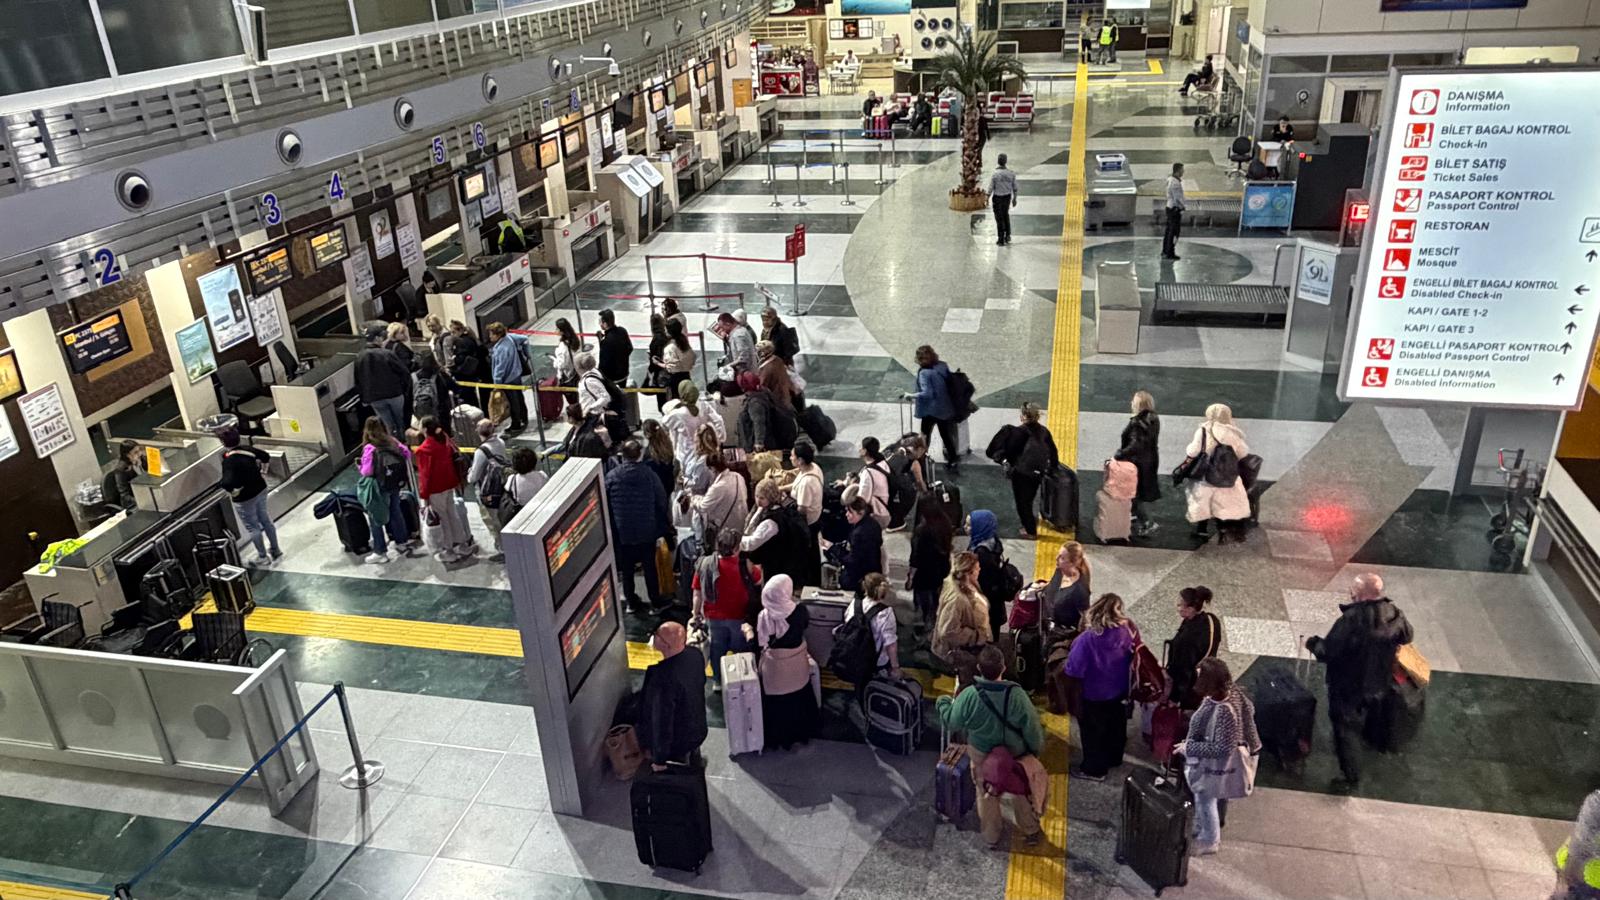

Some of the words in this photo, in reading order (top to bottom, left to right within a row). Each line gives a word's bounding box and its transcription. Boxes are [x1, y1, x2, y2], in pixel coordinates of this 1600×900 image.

[1447, 91, 1504, 102] DANIŞMA
[1445, 102, 1510, 112] Information
[474, 122, 486, 148] 6
[1441, 123, 1473, 135] BİLET
[1475, 125, 1514, 135] BAGAJ
[1516, 125, 1571, 135] KONTROL
[432, 136, 444, 164] 5
[1438, 139, 1487, 149] Check-in
[1434, 157, 1470, 169] BİLET
[1472, 158, 1507, 170] SATIŞ
[1433, 173, 1466, 182] Ticket
[1468, 173, 1499, 182] Sales
[330, 171, 344, 200] 4
[1428, 191, 1494, 200] PASAPORT
[1495, 191, 1556, 200] KONTROL
[263, 192, 281, 225] 3
[1426, 201, 1475, 211] Passport
[1478, 201, 1520, 211] Control
[1424, 221, 1490, 231] RESTORAN
[1418, 246, 1461, 256] MESCİT
[94, 247, 122, 286] 2
[1416, 258, 1458, 269] Mosque
[1412, 277, 1452, 288] ENGELLİ
[1452, 277, 1479, 288] BİLET
[1480, 279, 1513, 289] BAGAJ
[1515, 280, 1559, 290] KONTROL
[1410, 289, 1455, 299] Disabled
[1457, 290, 1503, 300] Check-in
[1407, 306, 1434, 316] KAPI
[1441, 307, 1471, 317] GATE
[1473, 308, 1489, 318] 1-2
[1404, 323, 1431, 333] KAPI
[1437, 324, 1466, 334] GATE
[1467, 325, 1475, 335] 3
[1401, 340, 1446, 350] ENGELLİ
[1448, 342, 1507, 352] PASAPORT
[1508, 342, 1561, 353] KONTROL
[1399, 350, 1443, 361] Disabled
[1444, 352, 1490, 363] Passport
[1491, 352, 1530, 363] Control
[1396, 367, 1441, 377] ENGELLİ
[1442, 369, 1492, 380] DANIŞMA
[1394, 377, 1437, 387] Disabled
